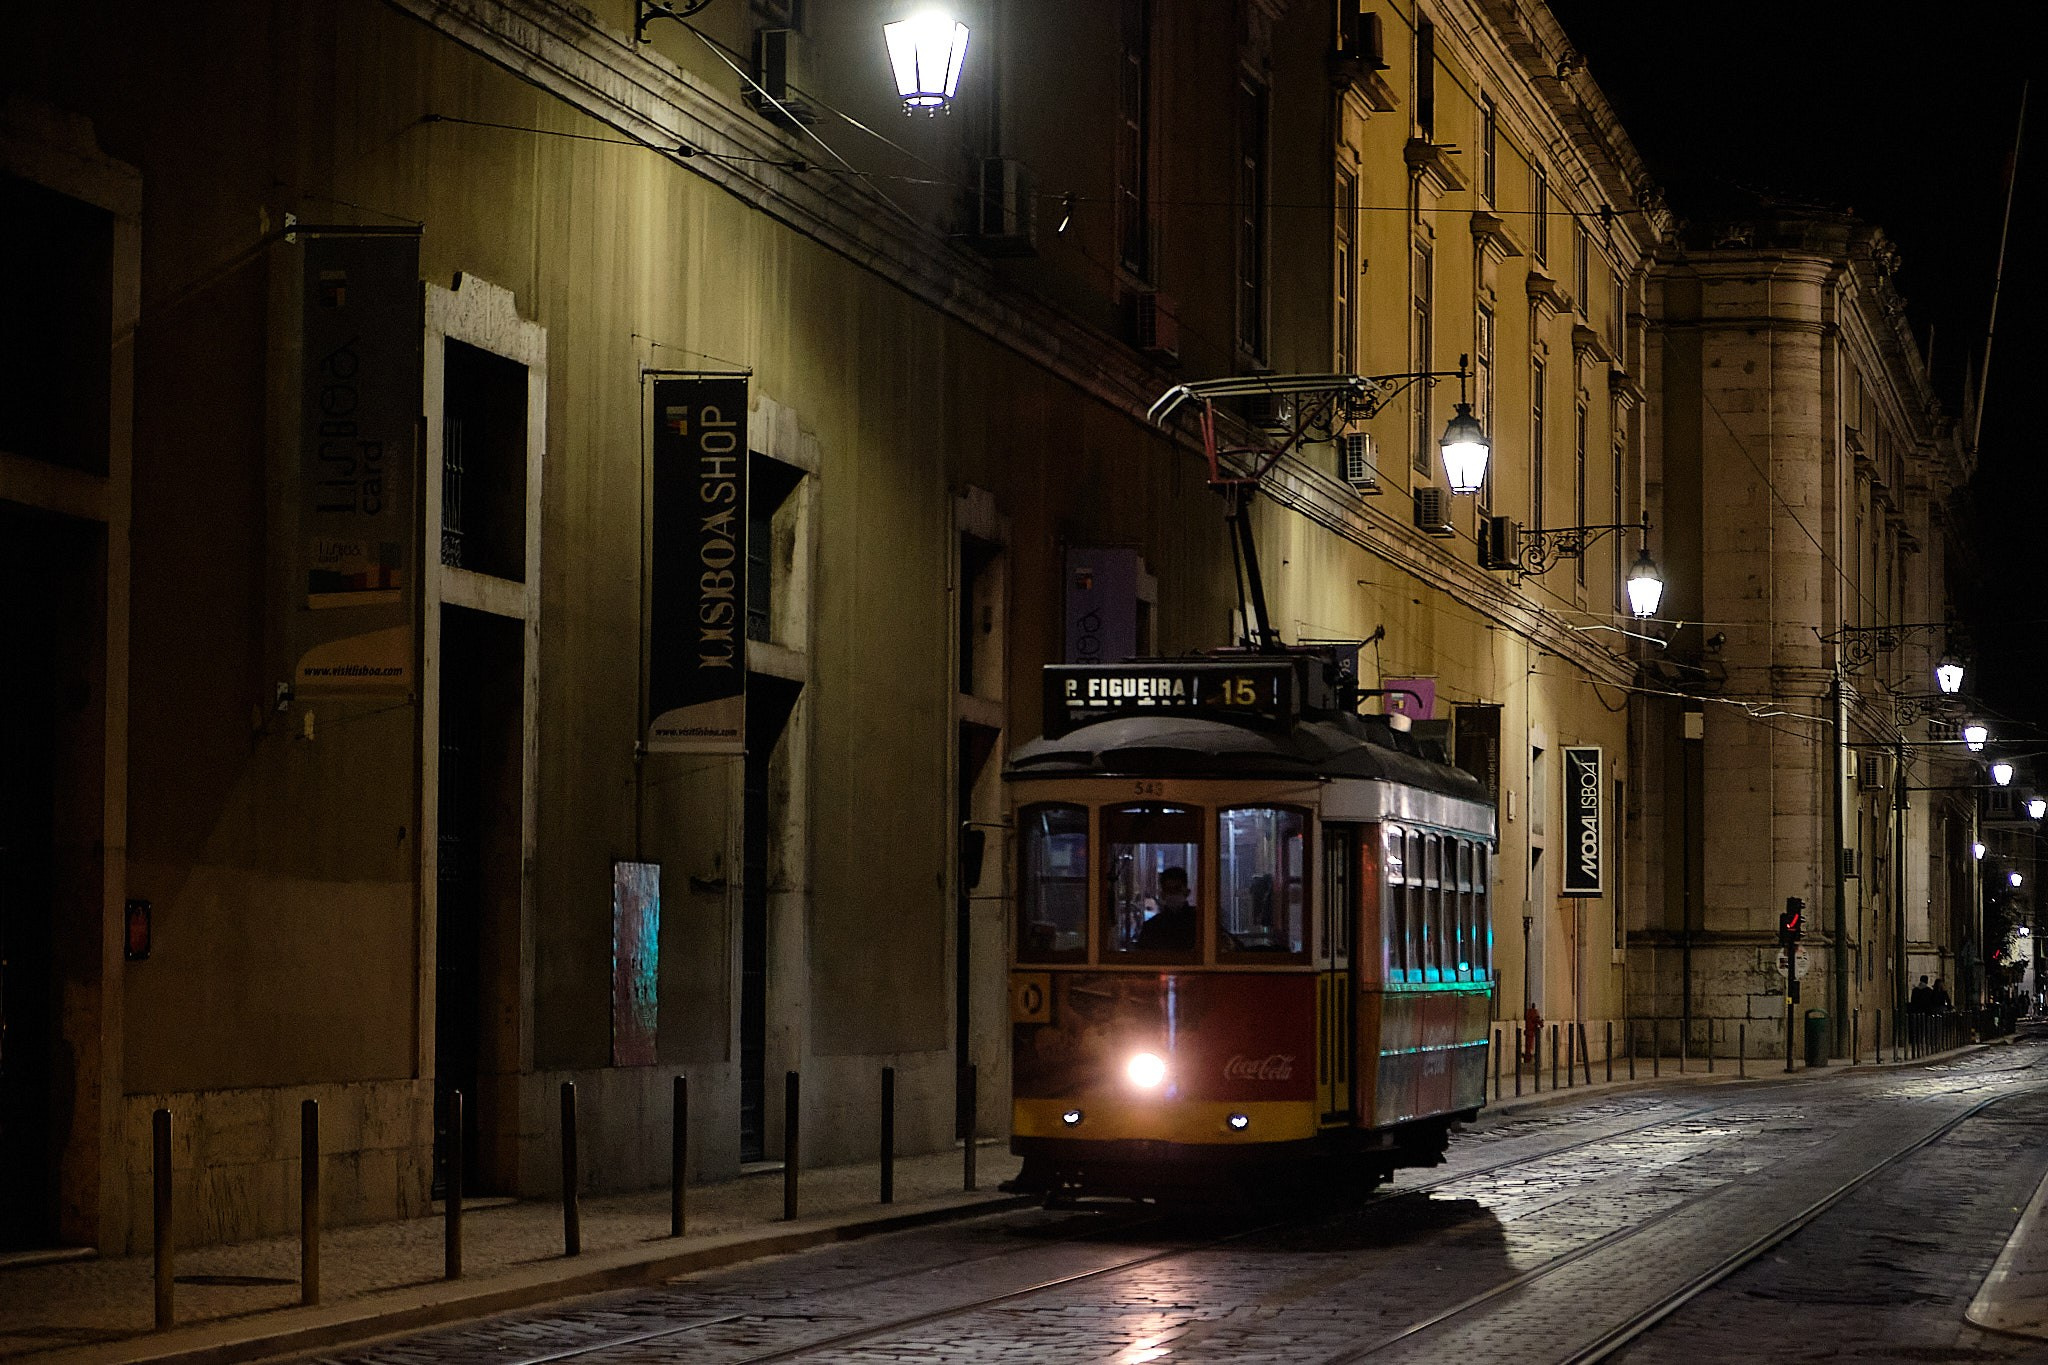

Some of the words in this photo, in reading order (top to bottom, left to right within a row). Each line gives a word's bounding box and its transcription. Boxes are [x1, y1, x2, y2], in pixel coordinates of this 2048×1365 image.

[358, 440, 384, 516] card
[304, 665, 403, 676] www.visitlisboa.com
[1065, 679, 1078, 697] P.
[1088, 678, 1185, 697] FIGUEIRA
[1222, 678, 1256, 705] 15
